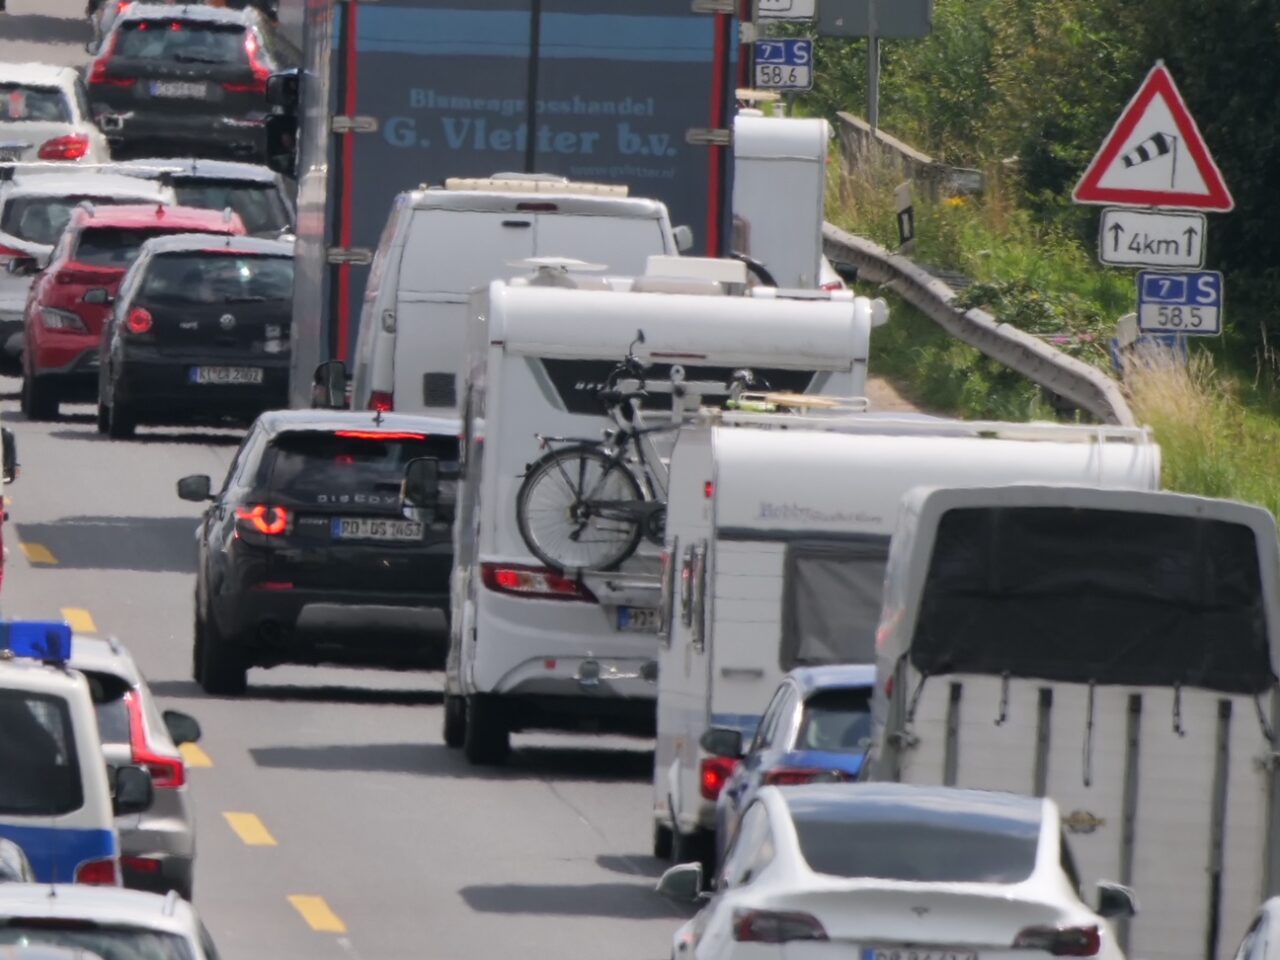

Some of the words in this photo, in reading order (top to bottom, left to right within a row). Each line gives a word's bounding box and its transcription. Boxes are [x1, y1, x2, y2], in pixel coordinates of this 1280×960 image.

[760, 44, 773, 59] 7
[793, 42, 809, 64] S
[383, 115, 431, 148] G.
[441, 117, 601, 155] Vletter
[617, 121, 679, 157] b.v.
[1128, 232, 1180, 256] 4km
[1158, 279, 1171, 297] 7
[1195, 275, 1218, 304] S
[1157, 305, 1203, 329] 58,5
